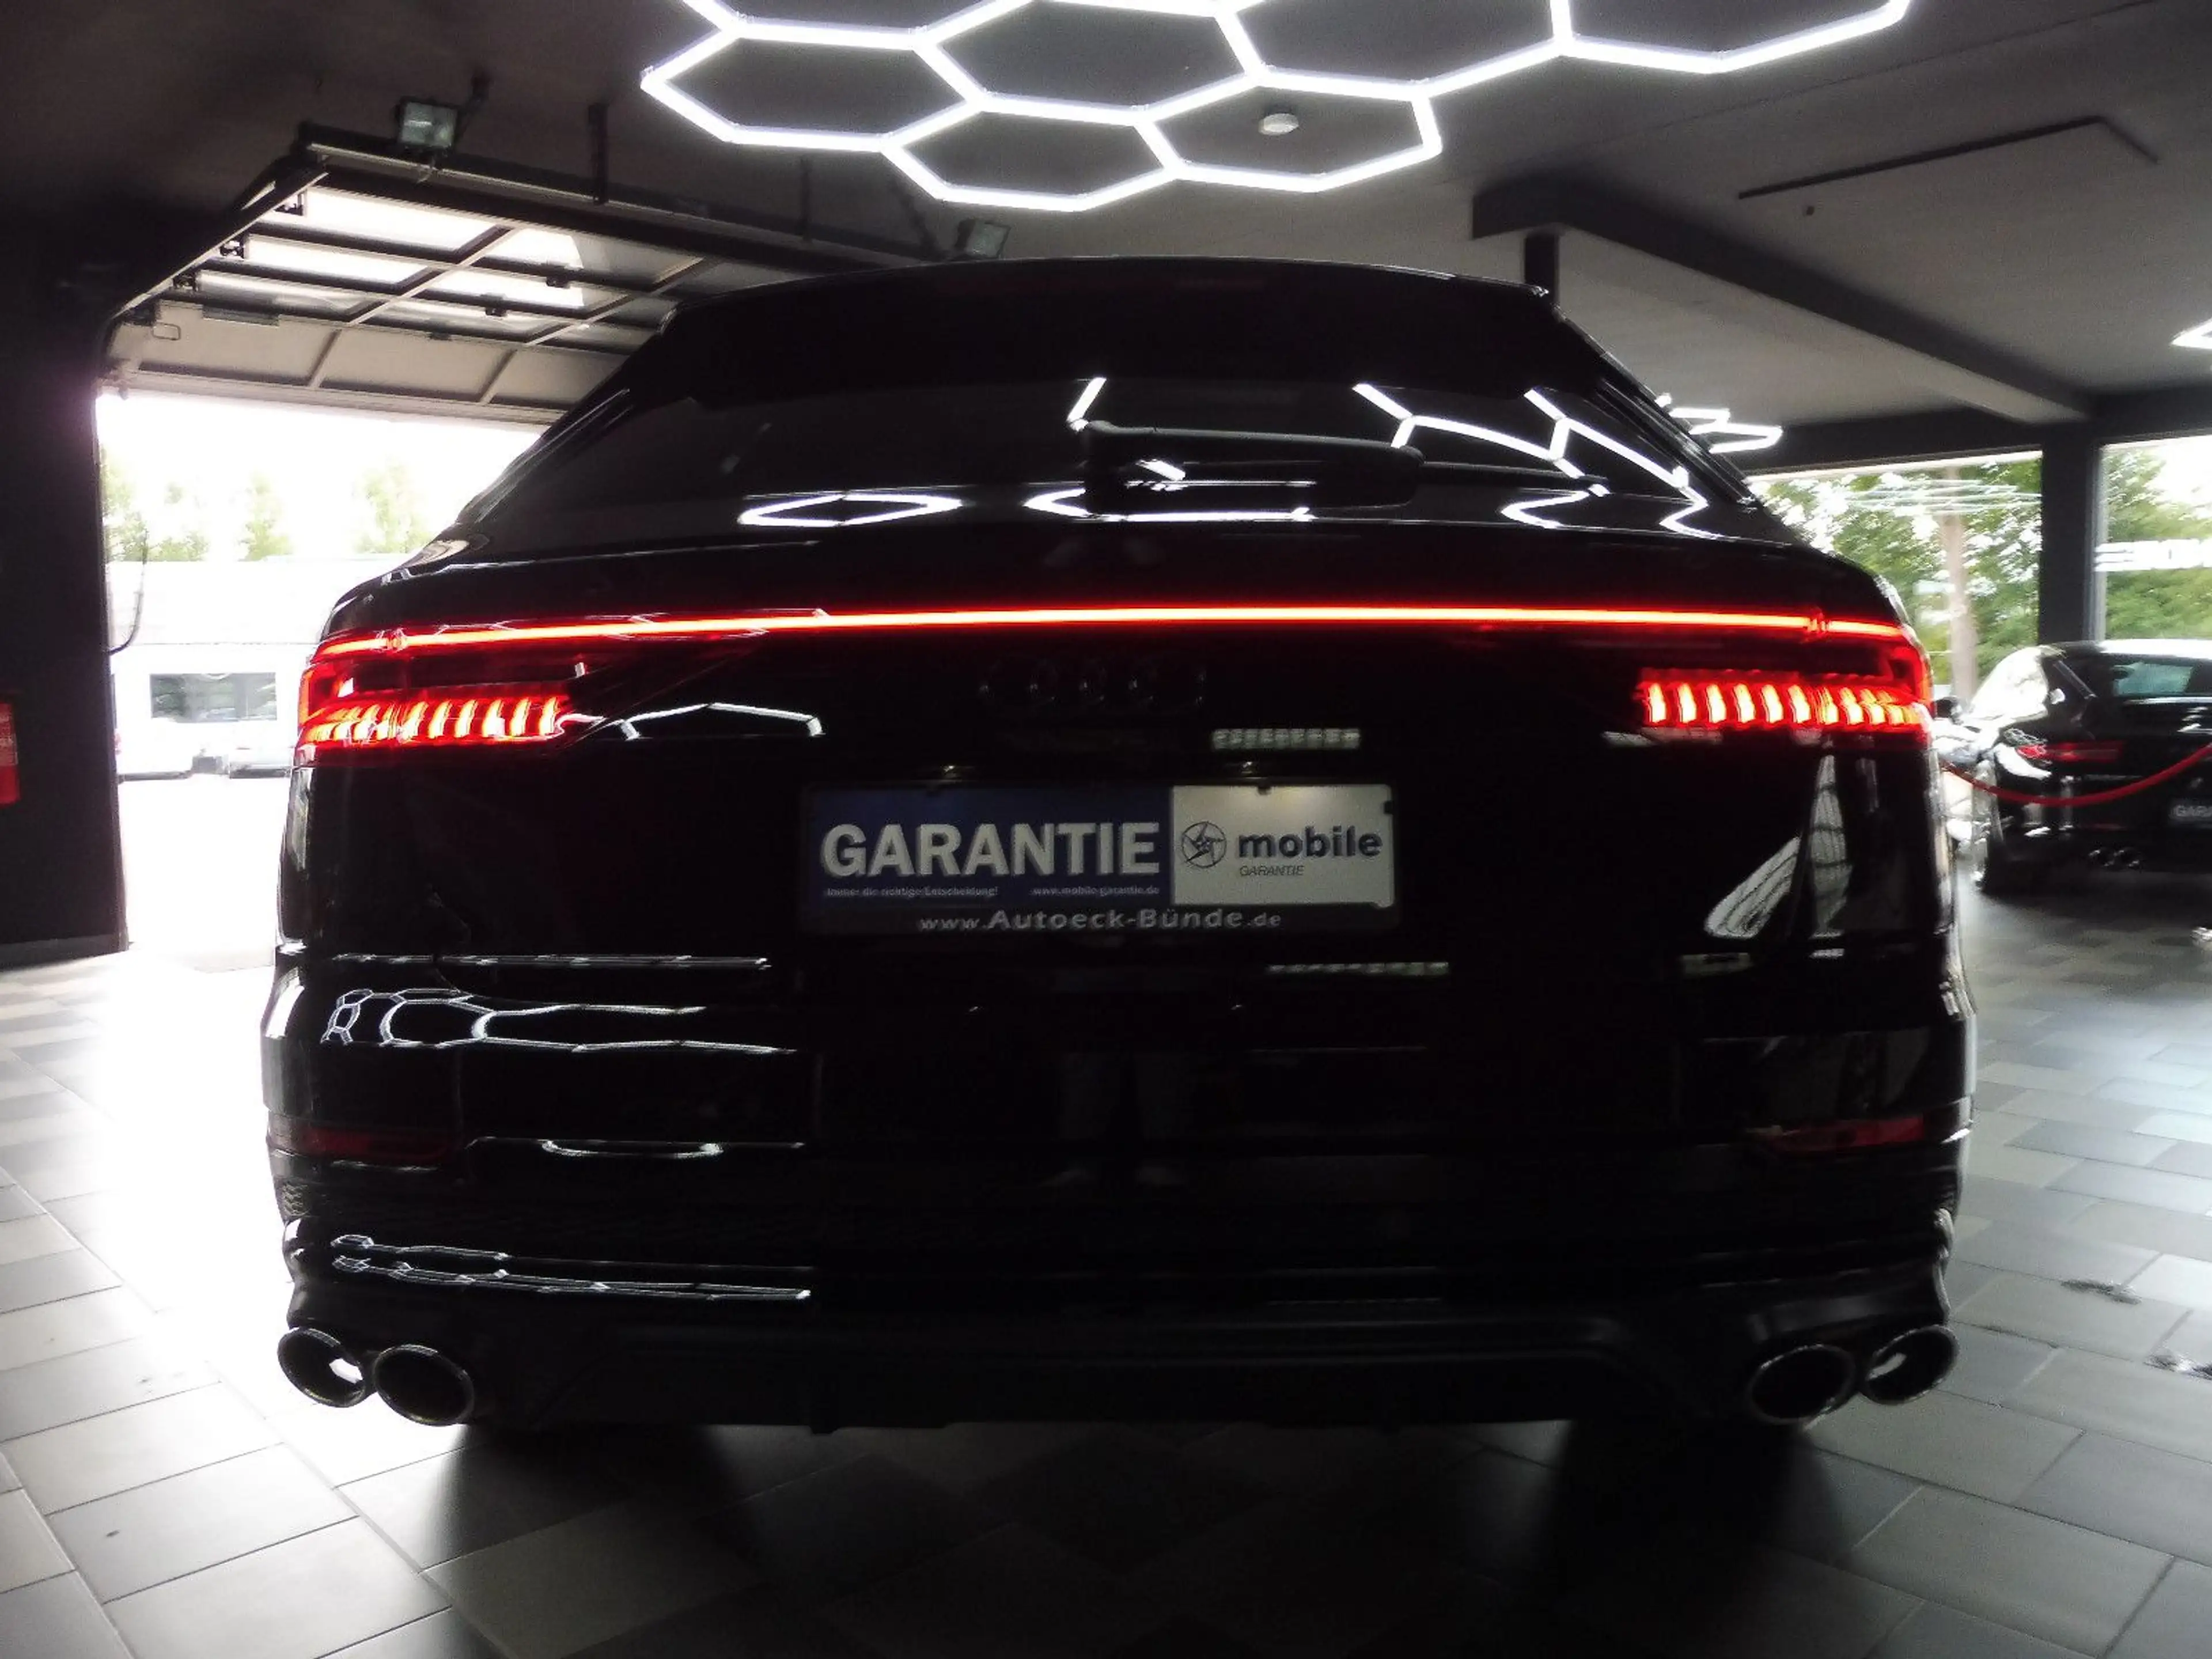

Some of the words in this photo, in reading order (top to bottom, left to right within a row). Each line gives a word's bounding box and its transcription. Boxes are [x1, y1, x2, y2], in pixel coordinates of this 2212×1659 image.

[820, 822, 1160, 877] GARANTIE
[1238, 825, 1383, 858] mobile
[1239, 865, 1305, 876] GARANTIE
[918, 908, 1282, 931] www.Autoeck-Bünde.de
